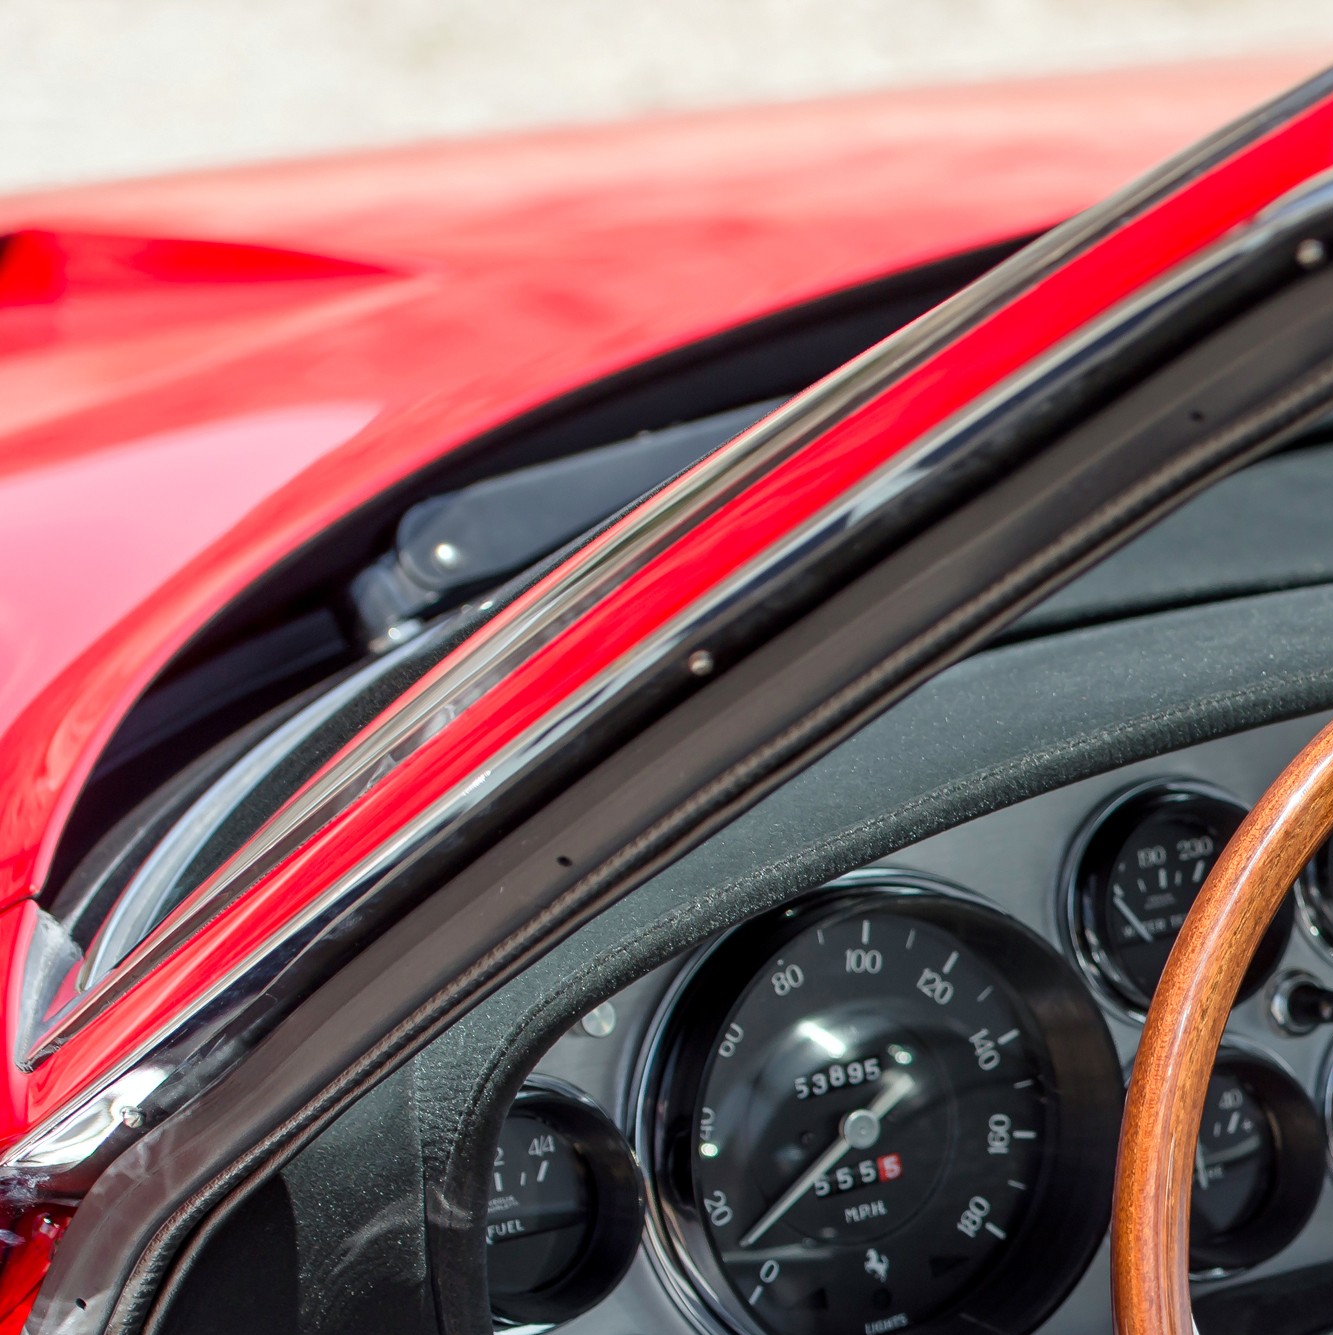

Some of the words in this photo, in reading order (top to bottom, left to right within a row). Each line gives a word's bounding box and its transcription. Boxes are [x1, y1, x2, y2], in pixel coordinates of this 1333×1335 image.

[771, 964, 804, 996] 80
[845, 948, 883, 975] 100
[916, 967, 954, 1005] 120
[968, 1028, 1001, 1071] 140
[794, 1058, 881, 1099] 53895
[987, 1113, 1011, 1155] 160
[704, 1190, 733, 1227] 20
[956, 1195, 991, 1238] 180
[487, 1219, 525, 1238] FUEL
[759, 1259, 780, 1284] 0
